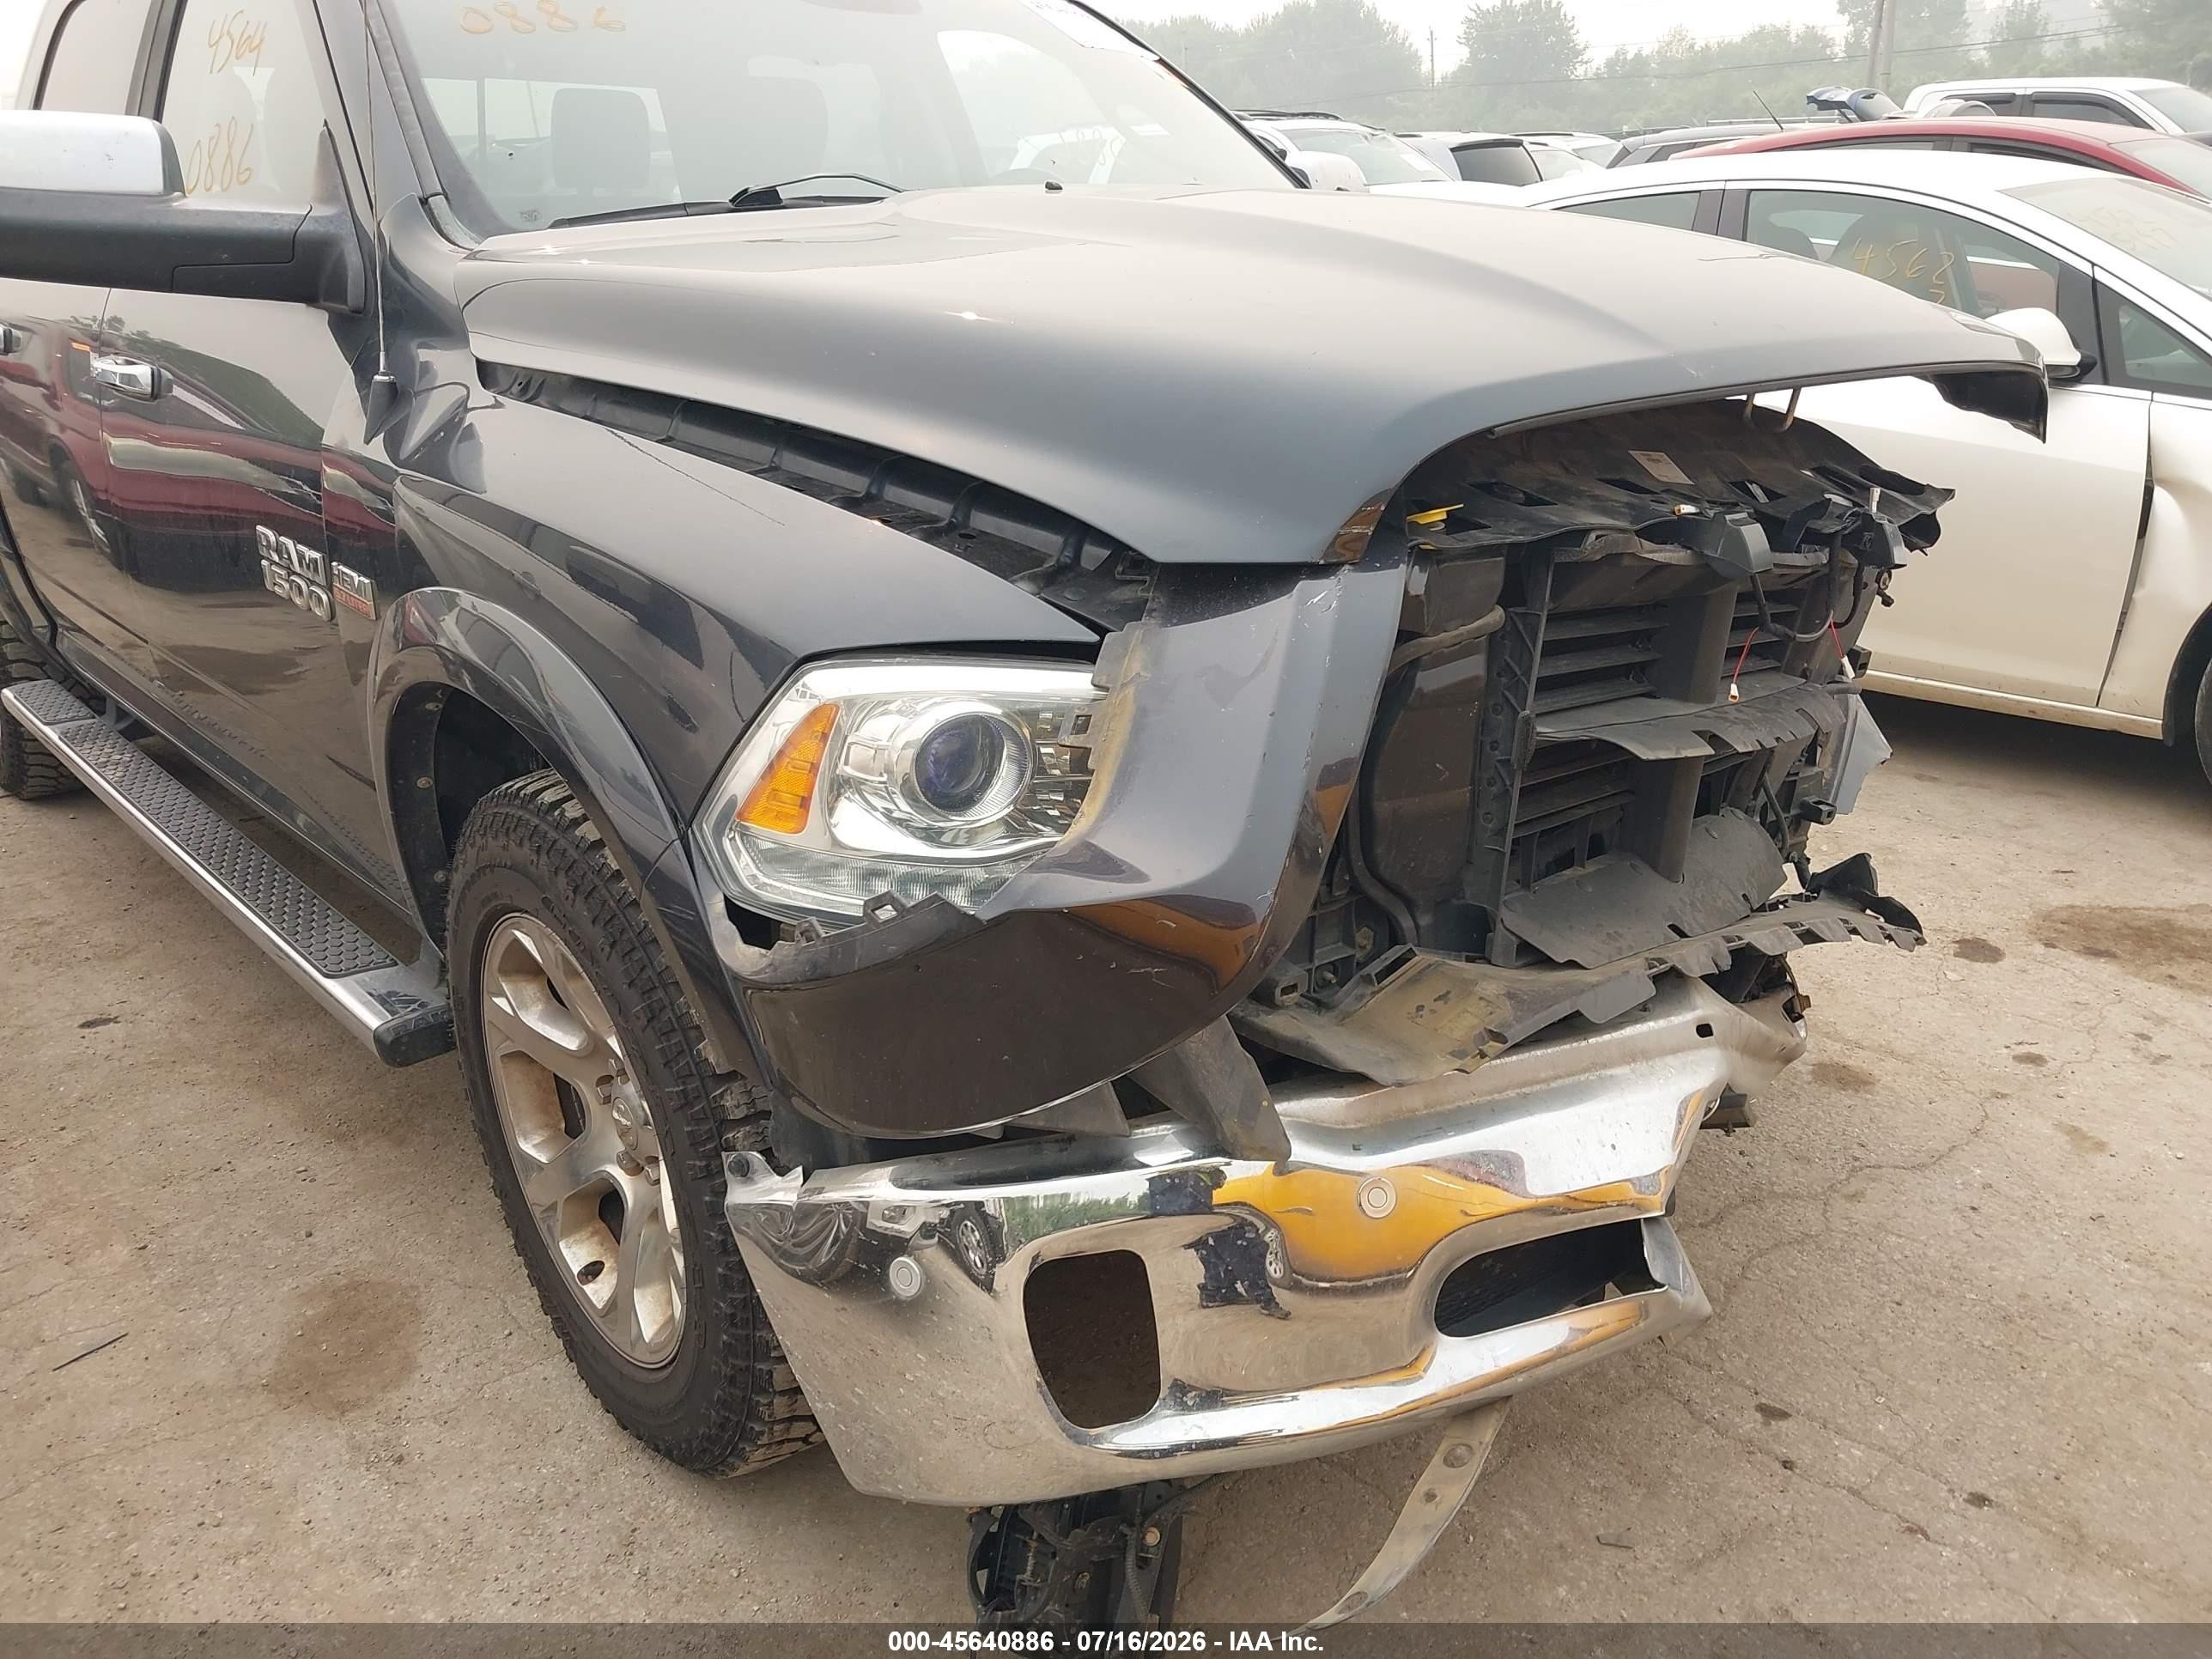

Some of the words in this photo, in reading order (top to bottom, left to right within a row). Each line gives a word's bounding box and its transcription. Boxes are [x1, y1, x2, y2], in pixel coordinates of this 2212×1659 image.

[206, 9, 268, 76] 4564
[459, 0, 627, 34] 0886
[185, 115, 254, 196] 0886
[1852, 237, 1955, 285] 4562
[256, 525, 330, 587] RAM
[331, 561, 374, 602] HEMI
[260, 559, 335, 622] 1500
